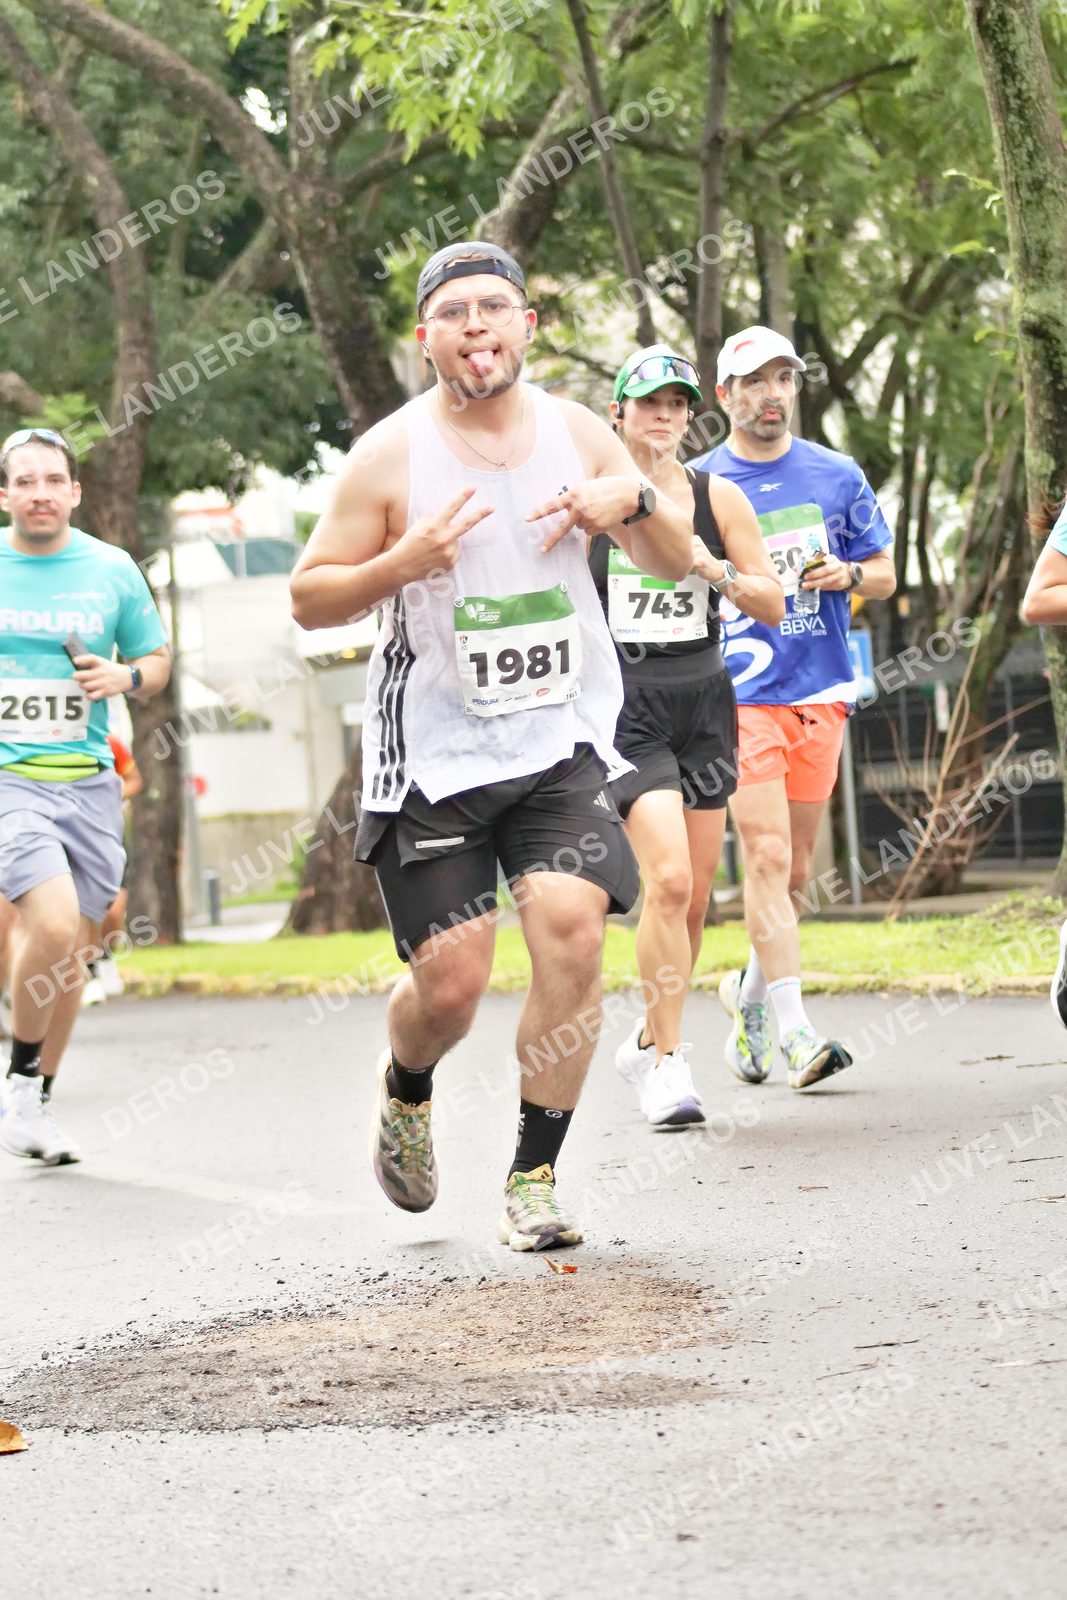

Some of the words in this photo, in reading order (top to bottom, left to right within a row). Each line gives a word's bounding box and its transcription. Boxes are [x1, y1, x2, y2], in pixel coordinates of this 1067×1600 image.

[628, 592, 694, 619] 743
[780, 615, 826, 636] BBVA
[469, 639, 570, 688] 1981
[1, 695, 84, 721] 2615
